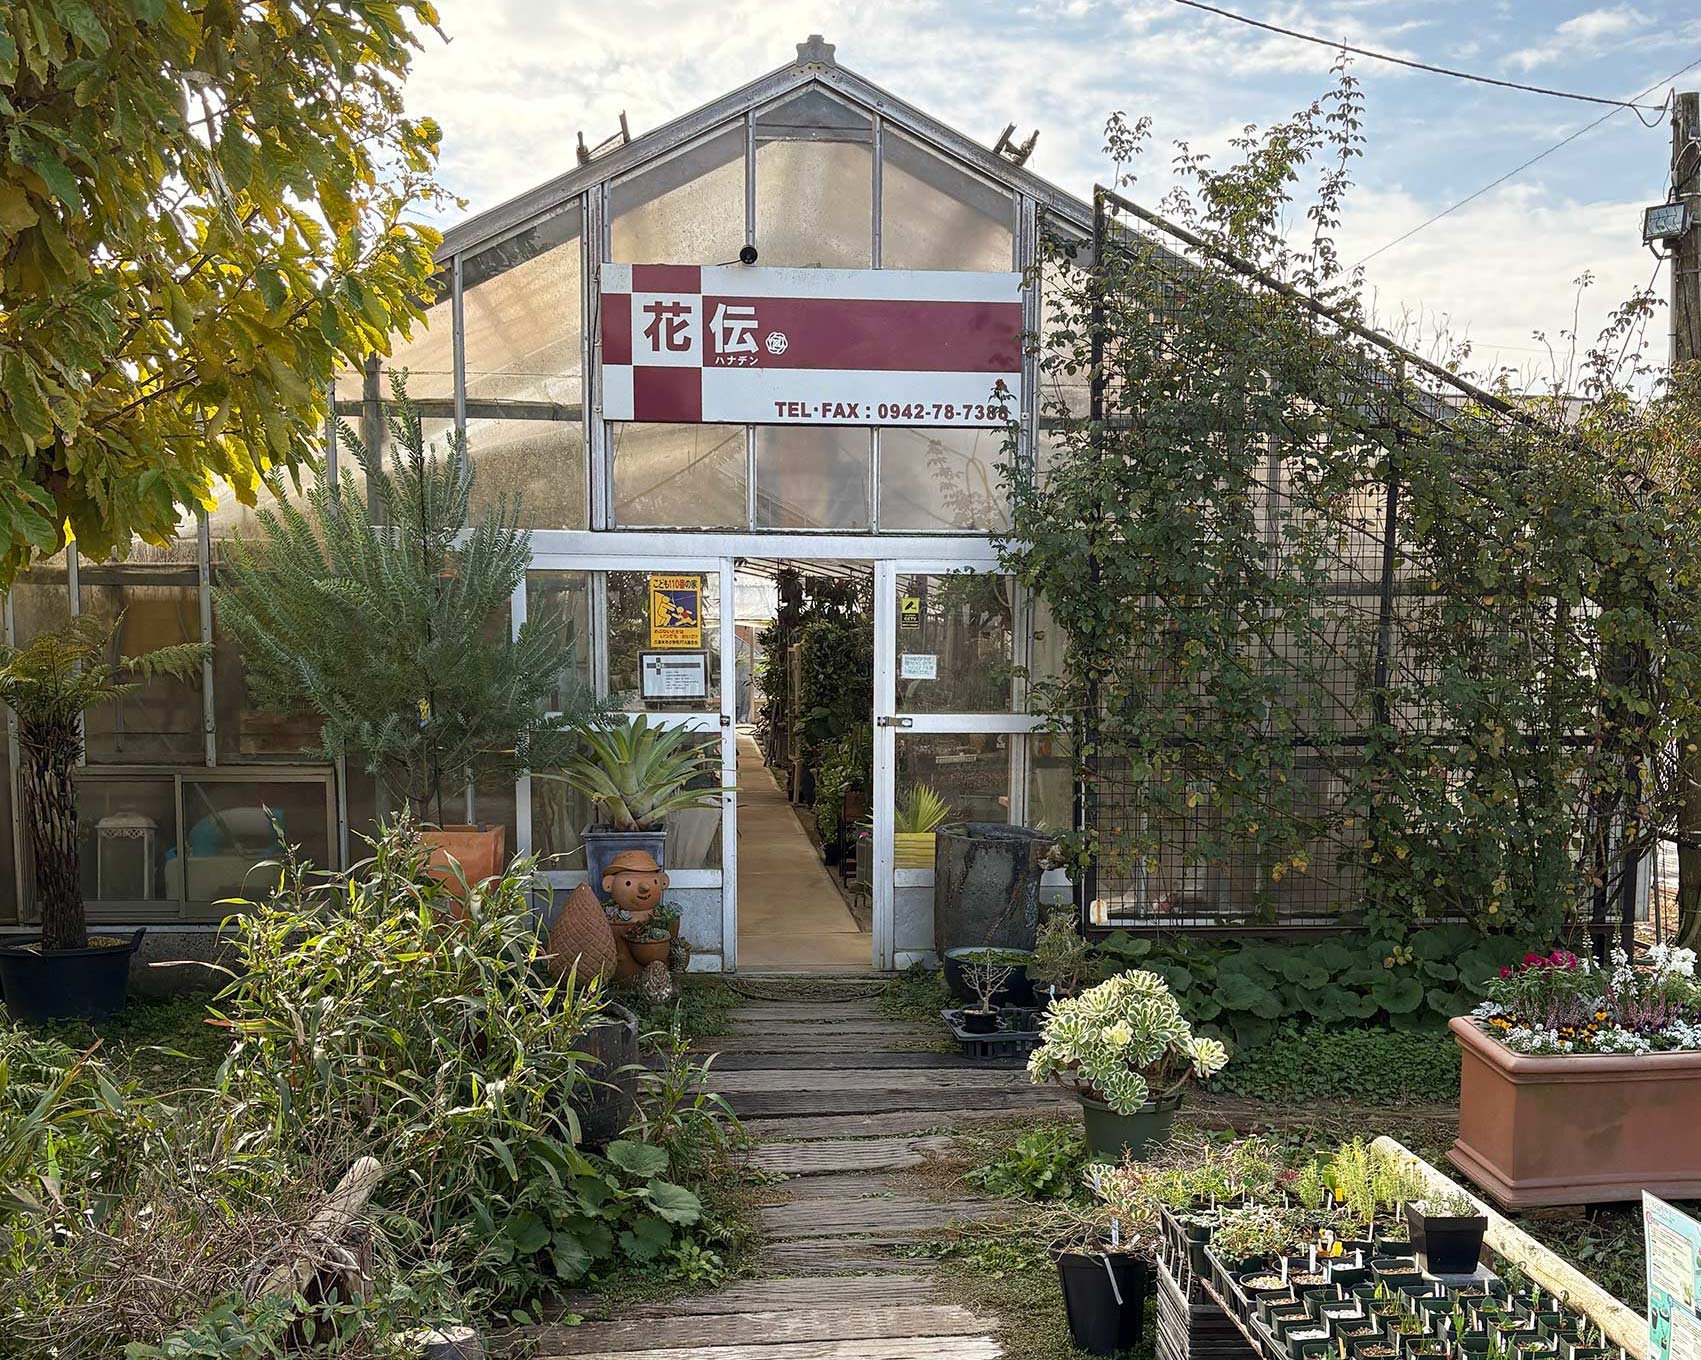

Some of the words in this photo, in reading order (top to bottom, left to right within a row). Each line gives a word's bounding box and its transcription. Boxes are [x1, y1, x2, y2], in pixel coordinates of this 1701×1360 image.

[643, 301, 760, 353] 花伝
[715, 355, 759, 366] ハナデン
